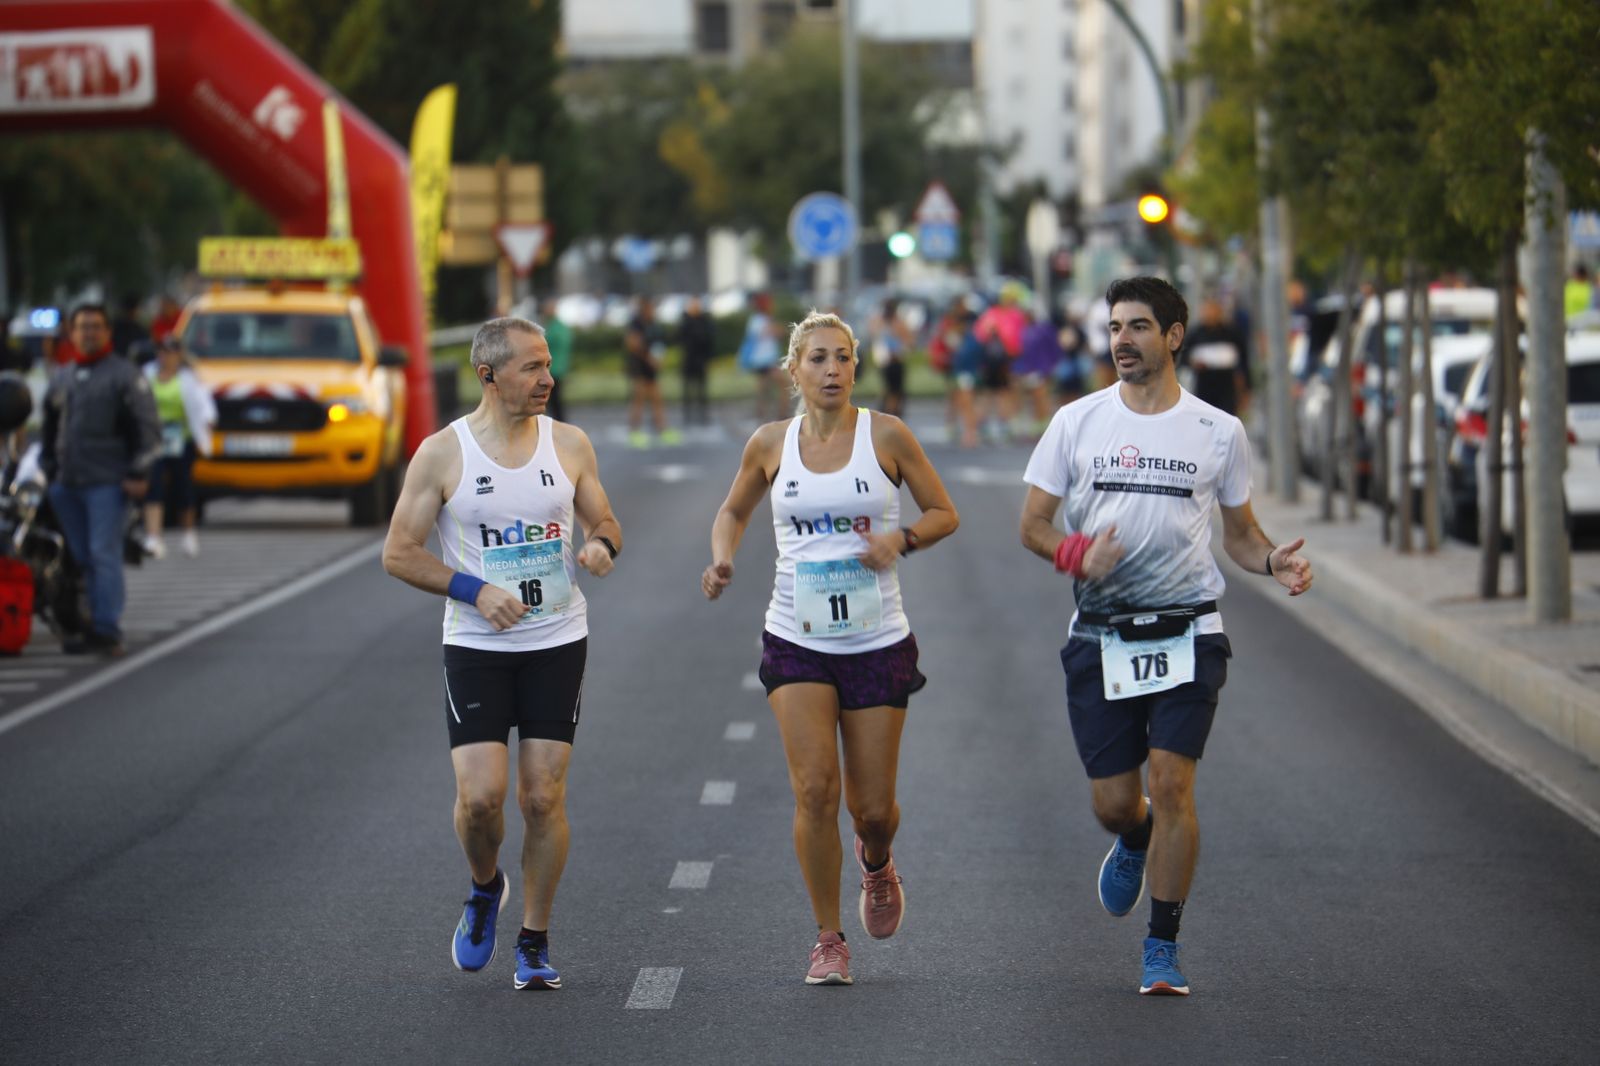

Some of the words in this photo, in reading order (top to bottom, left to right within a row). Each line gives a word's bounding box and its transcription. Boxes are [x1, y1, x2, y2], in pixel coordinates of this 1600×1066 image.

[1093, 456, 1106, 469] EL
[1103, 483, 1184, 496] www.elhostelero.com
[486, 560, 518, 571] MEDIA
[798, 573, 826, 582] MEDIA
[518, 578, 543, 607] 16
[828, 593, 849, 622] 11
[1130, 651, 1168, 682] 176
